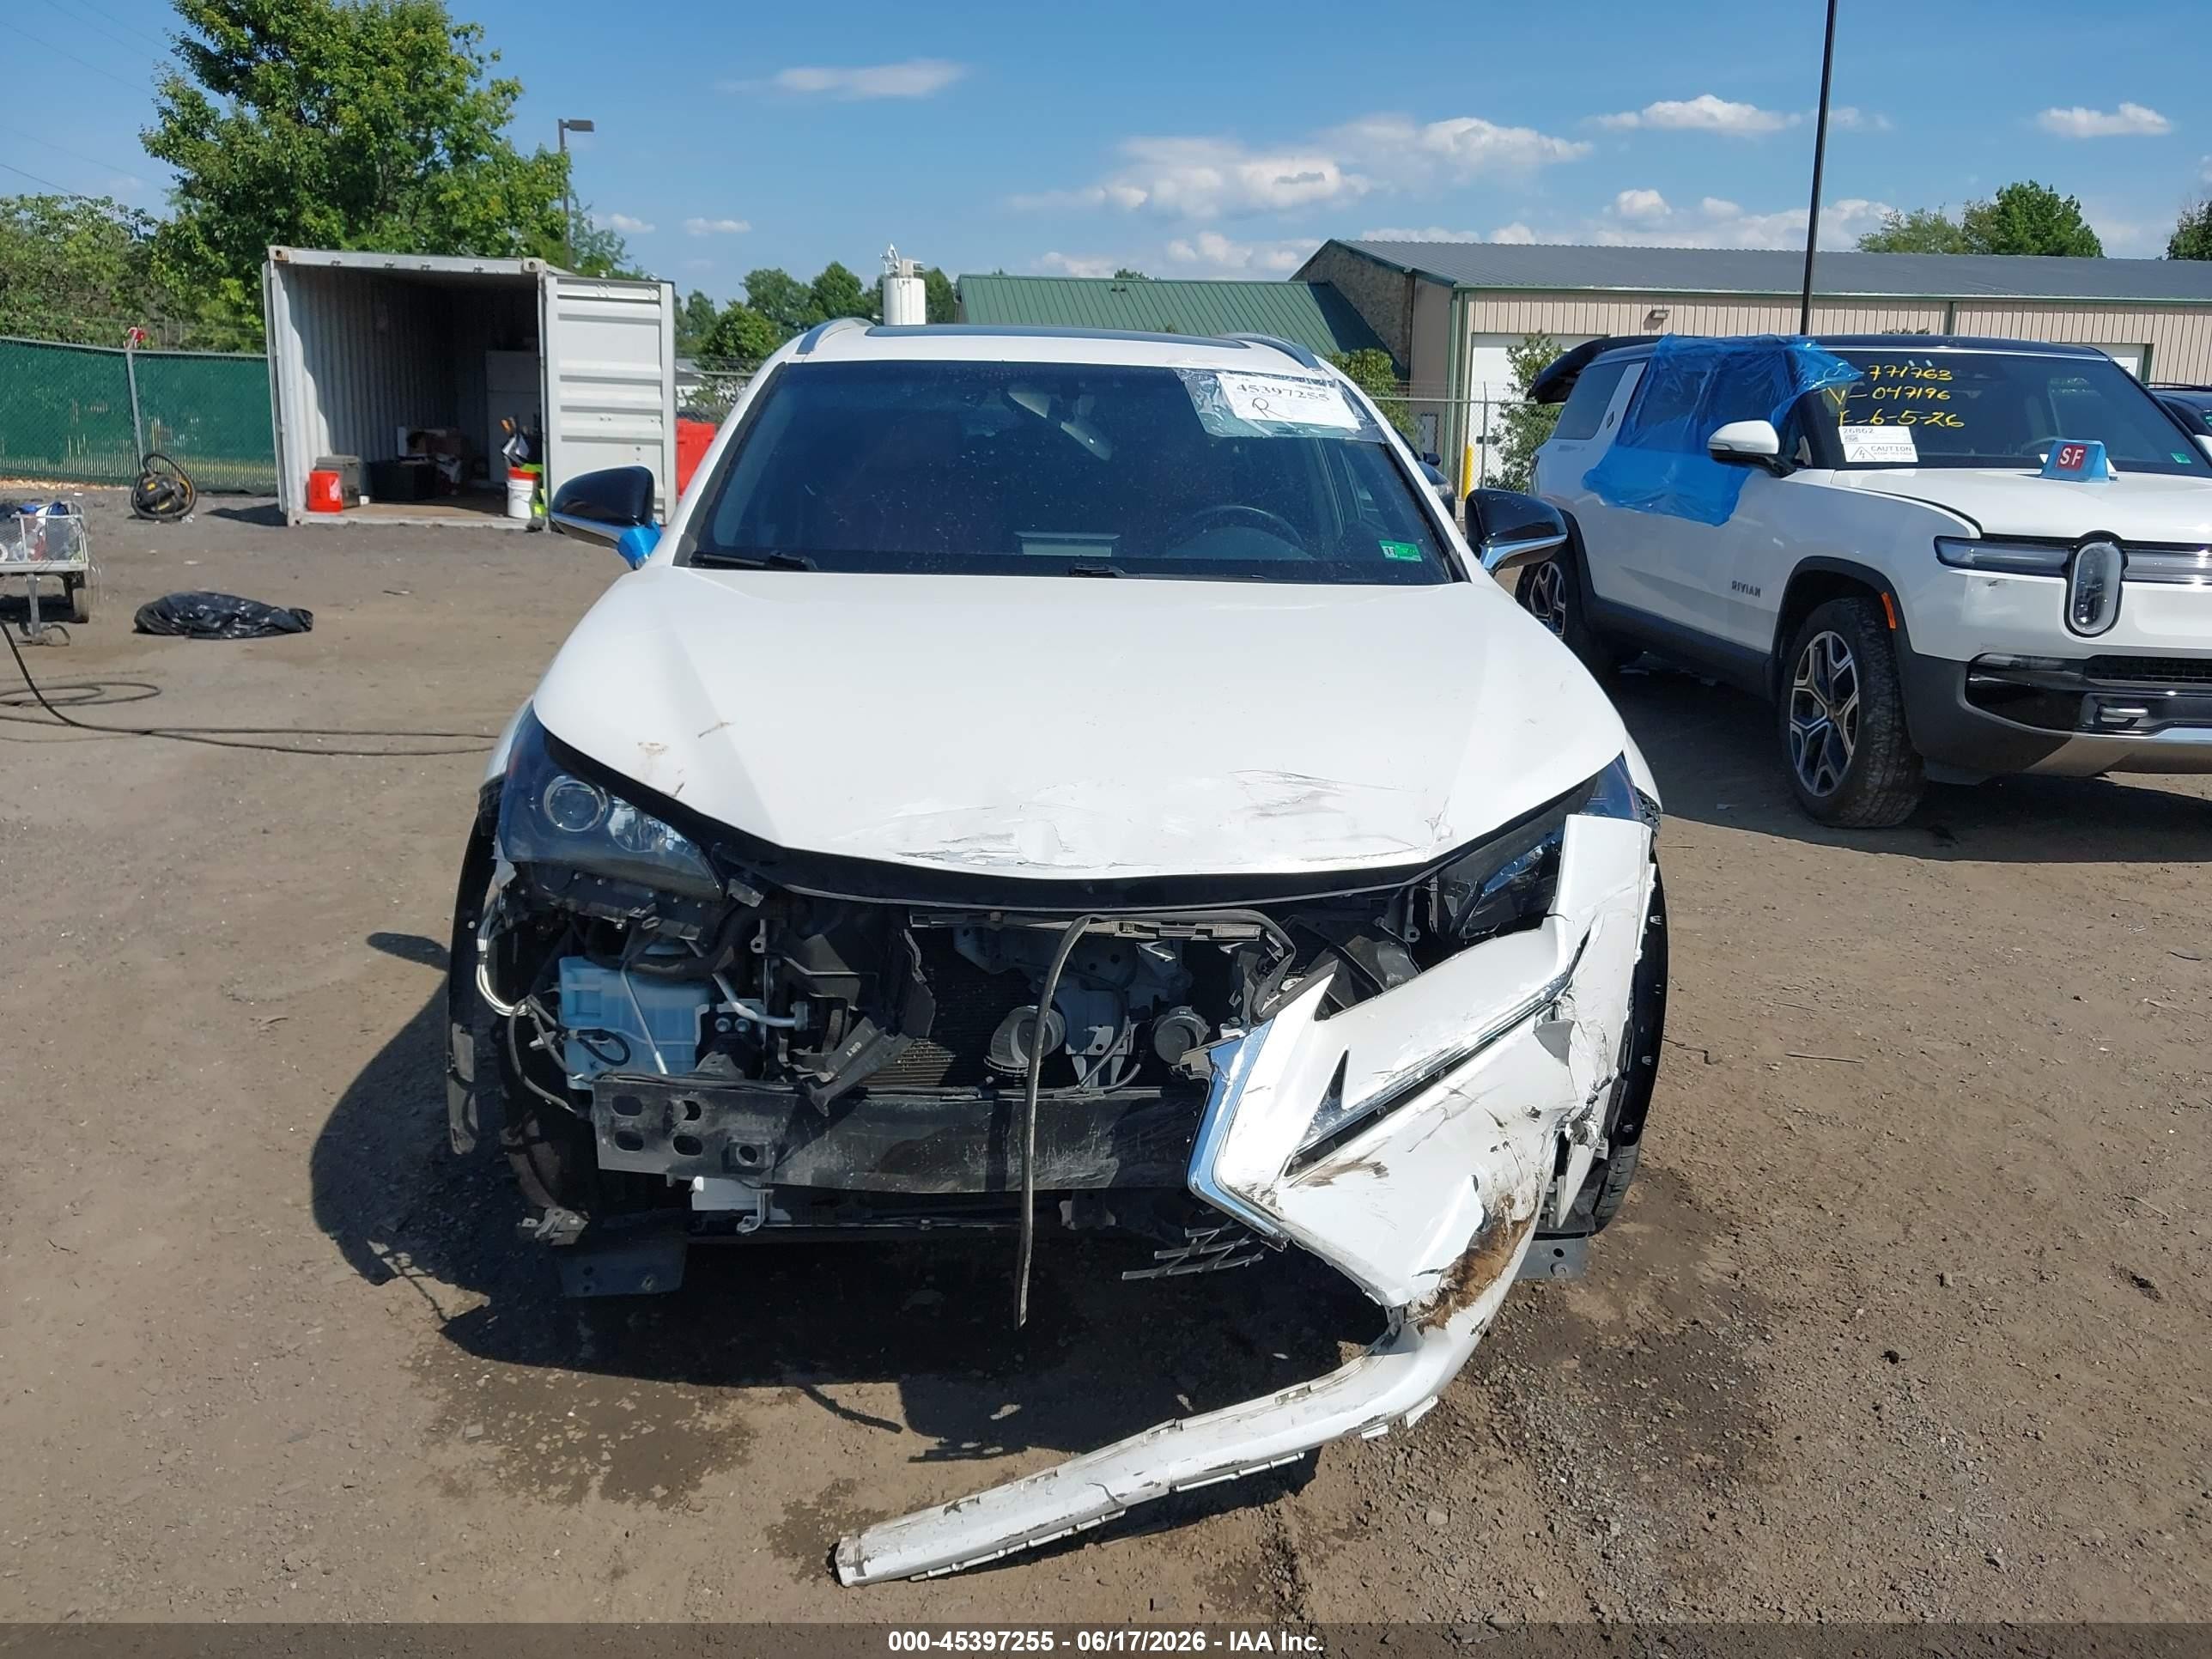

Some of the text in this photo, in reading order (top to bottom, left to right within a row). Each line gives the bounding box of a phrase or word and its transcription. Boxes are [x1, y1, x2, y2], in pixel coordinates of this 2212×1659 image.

[1237, 383, 1330, 402] 45397255
[2059, 447, 2084, 465] SF
[1731, 580, 1761, 599] RIVIAN
